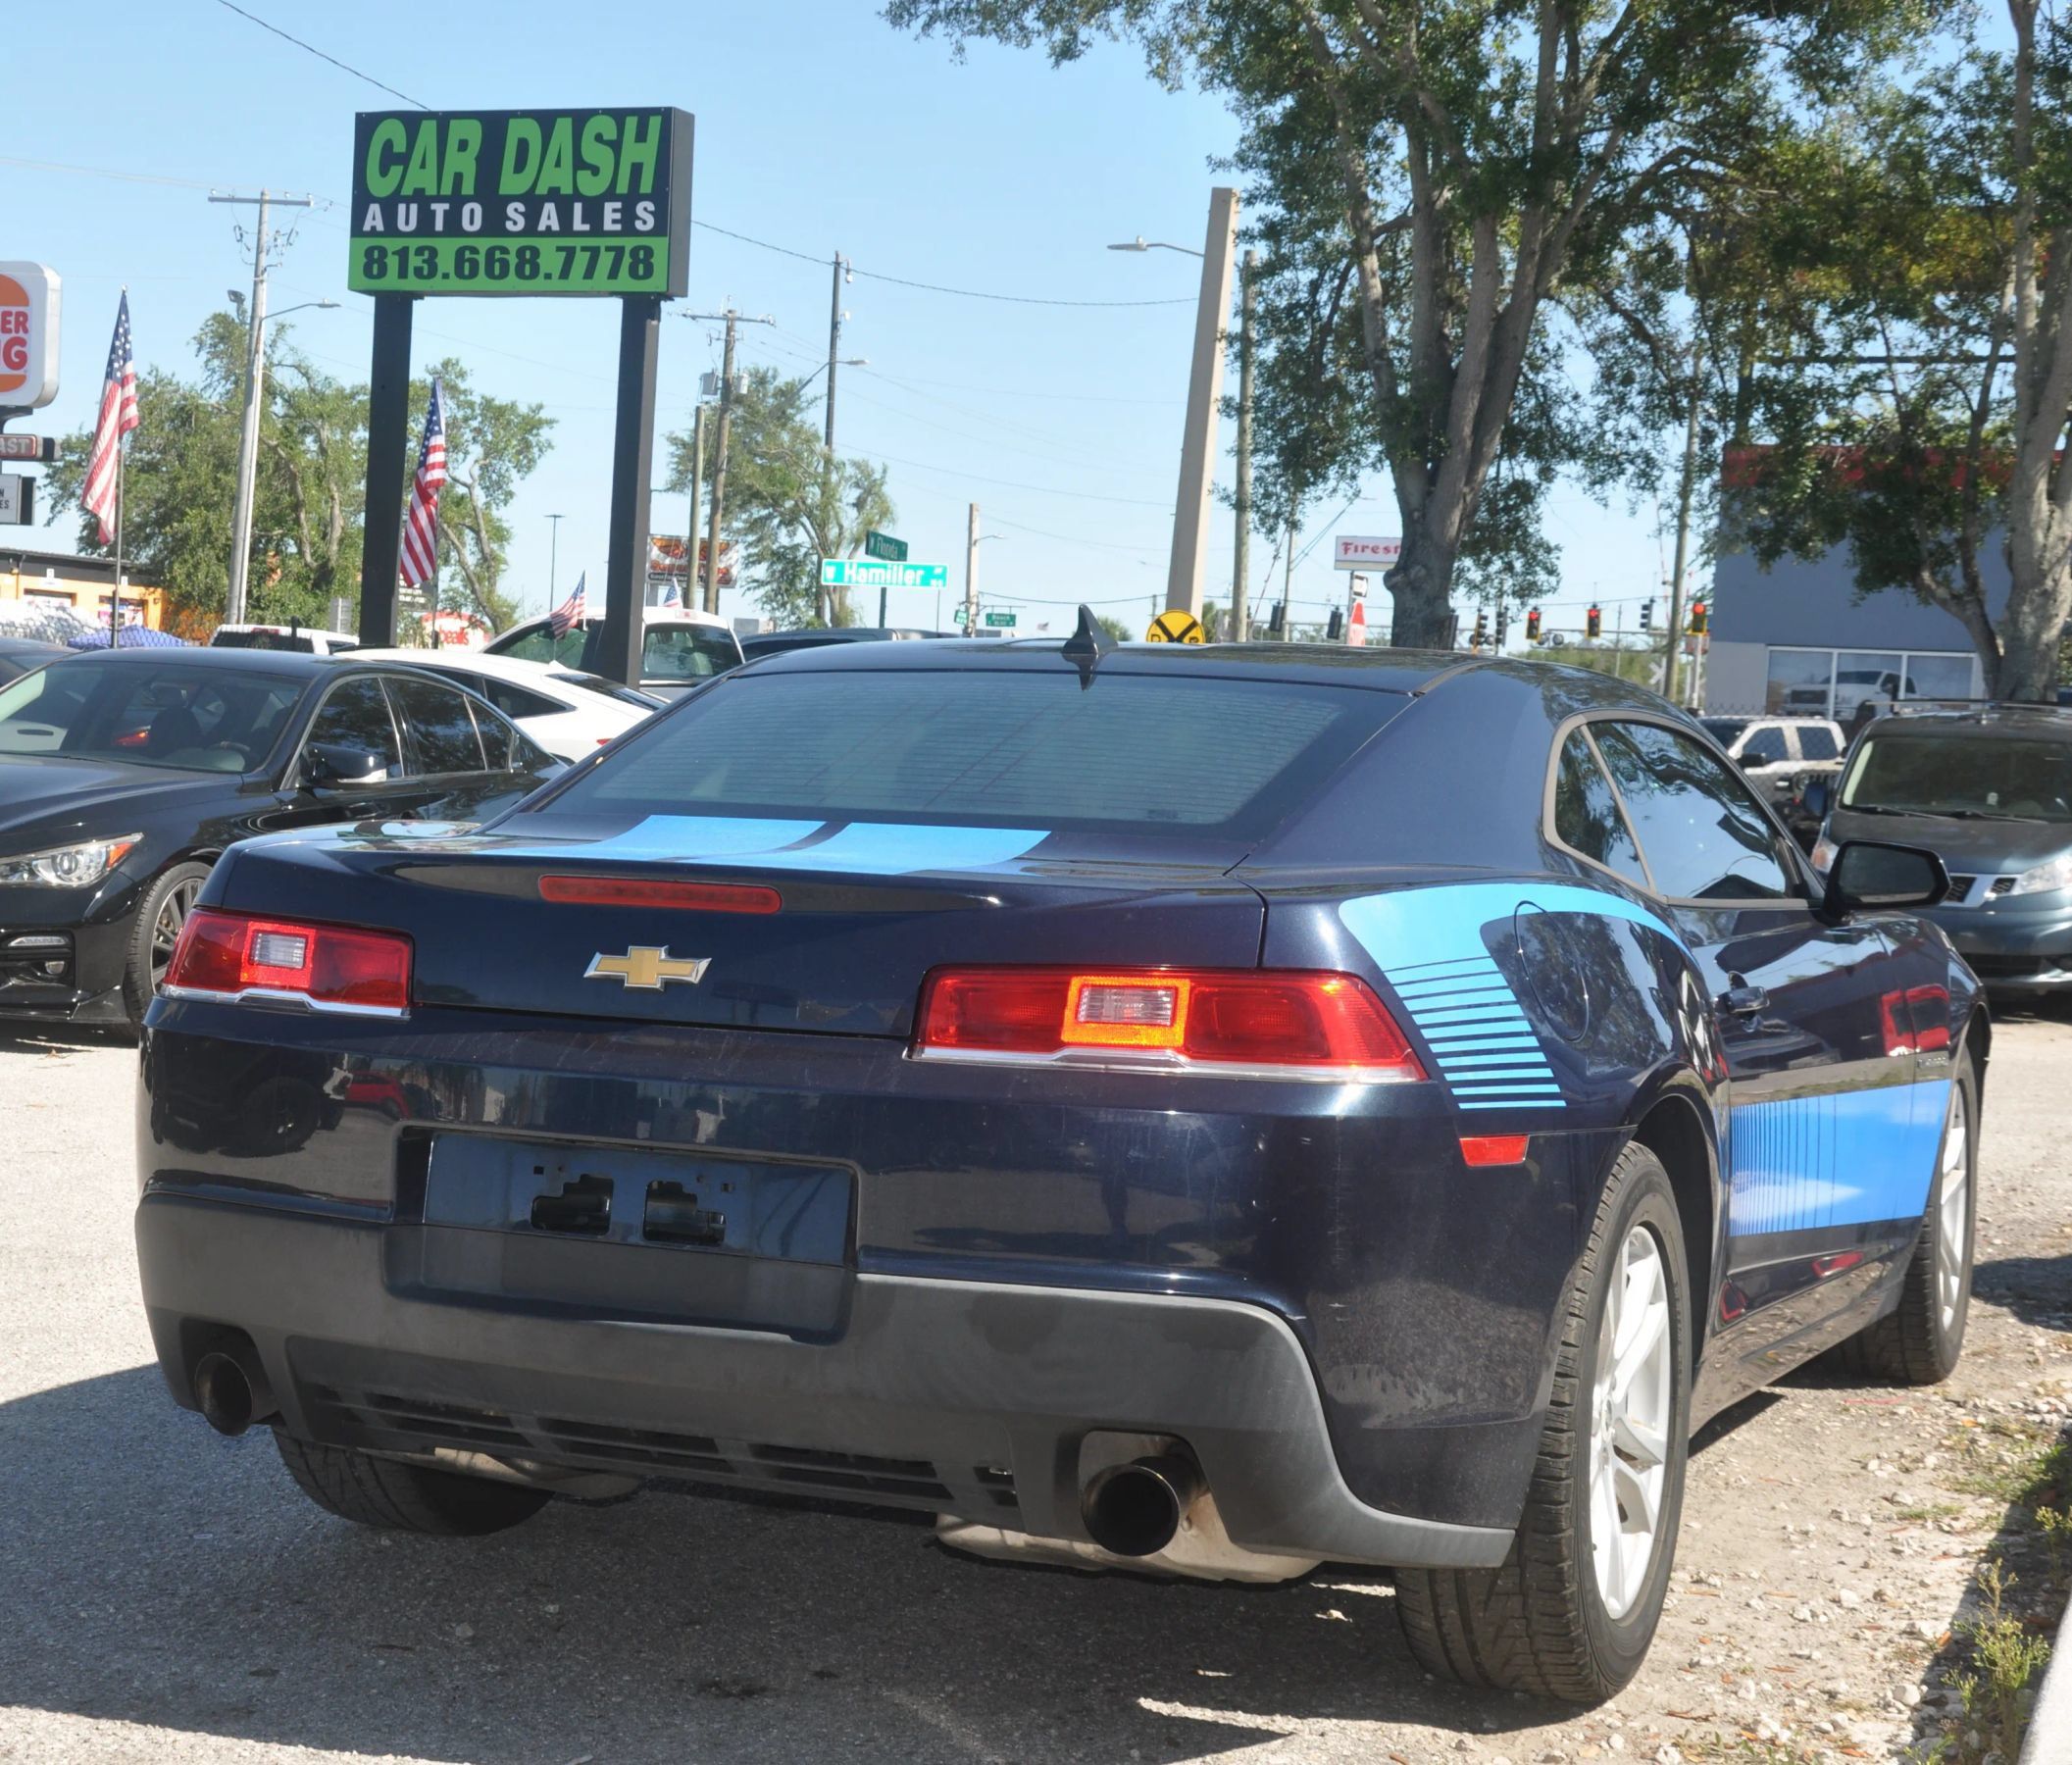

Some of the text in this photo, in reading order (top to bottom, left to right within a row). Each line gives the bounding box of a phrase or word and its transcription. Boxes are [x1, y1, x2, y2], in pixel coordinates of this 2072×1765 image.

[366, 115, 663, 198] CAR DASH
[363, 201, 656, 232] AUTO SALES
[363, 245, 655, 280] 813.668.7778
